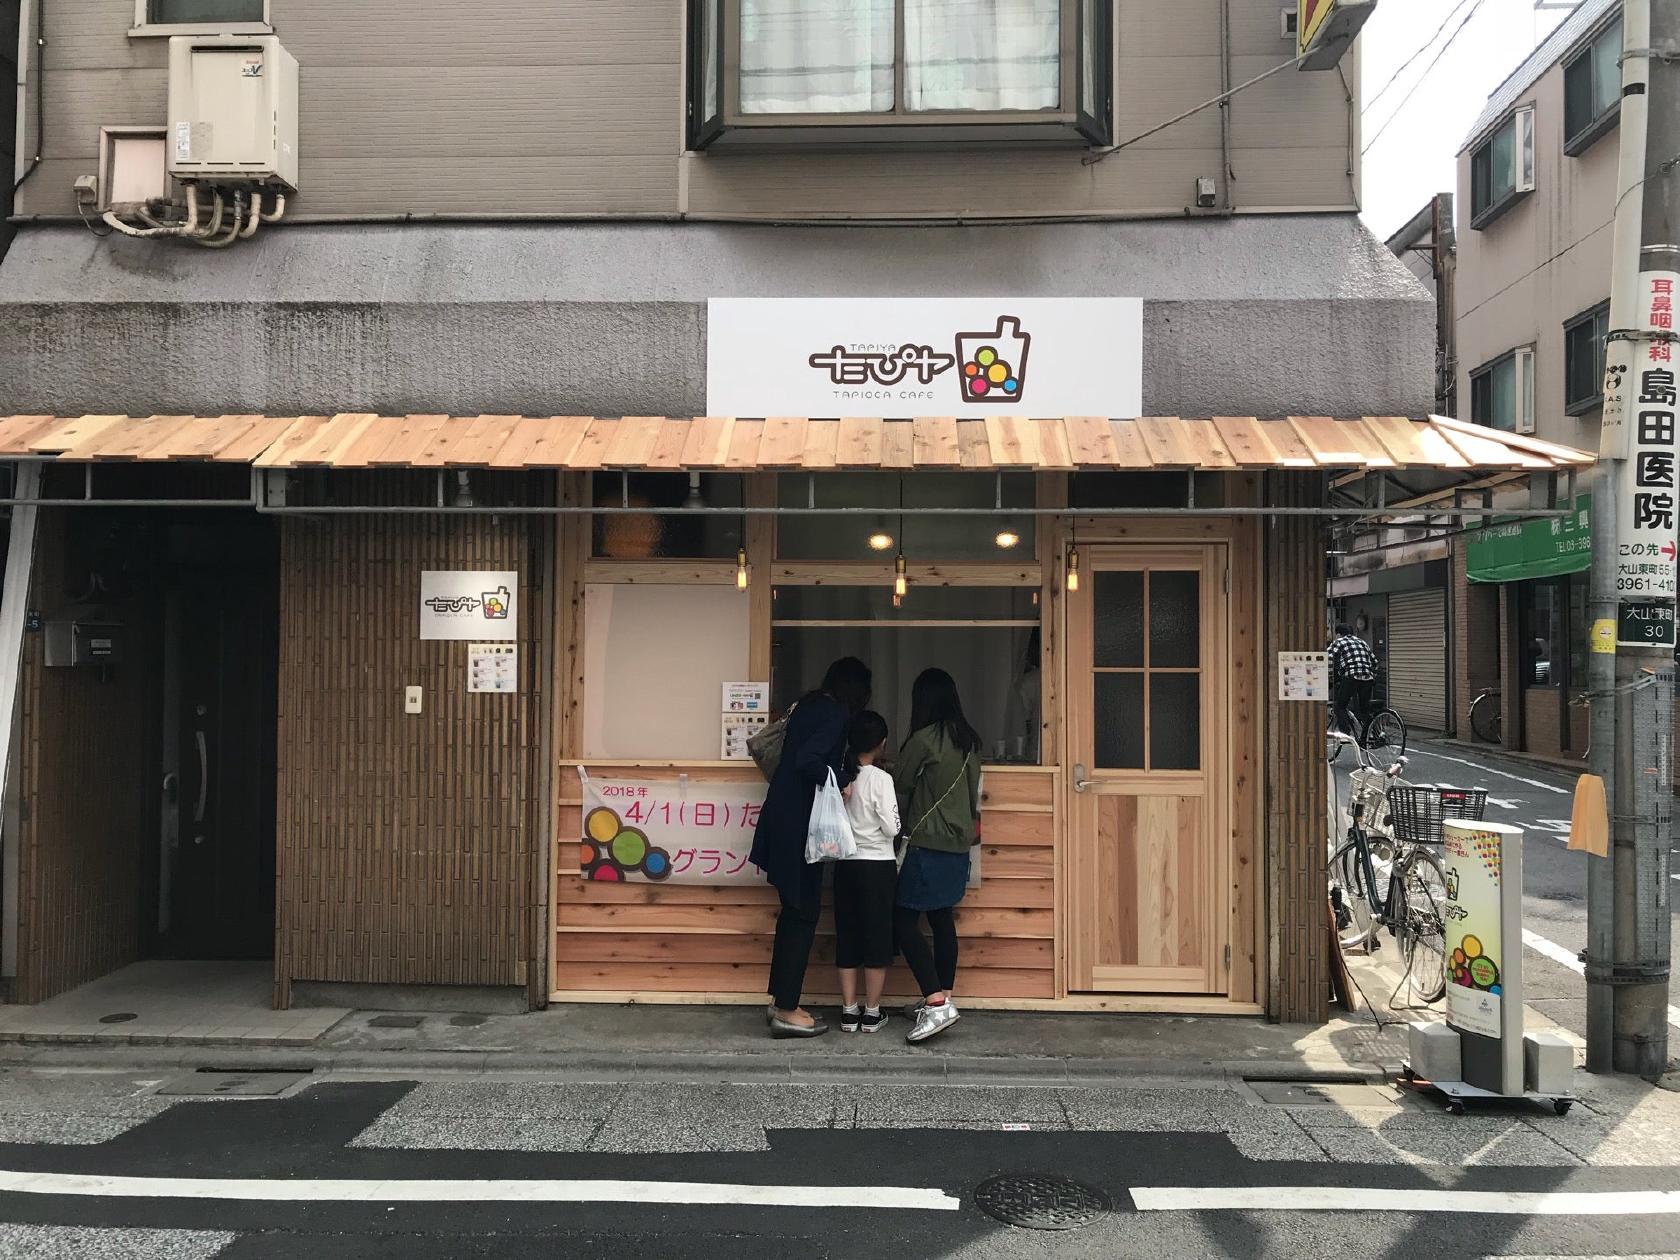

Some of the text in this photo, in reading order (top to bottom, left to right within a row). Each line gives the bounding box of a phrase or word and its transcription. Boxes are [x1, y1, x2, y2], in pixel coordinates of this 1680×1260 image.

[850, 343, 896, 352] TAPIYA
[833, 391, 935, 399] TAPIOCA CAFE
[1633, 367, 1677, 531] 島田医院
[1619, 543, 1659, 556] この先
[1626, 607, 1673, 621] 大山東町
[1644, 625, 1664, 638] 30
[602, 785, 649, 798] 2018年
